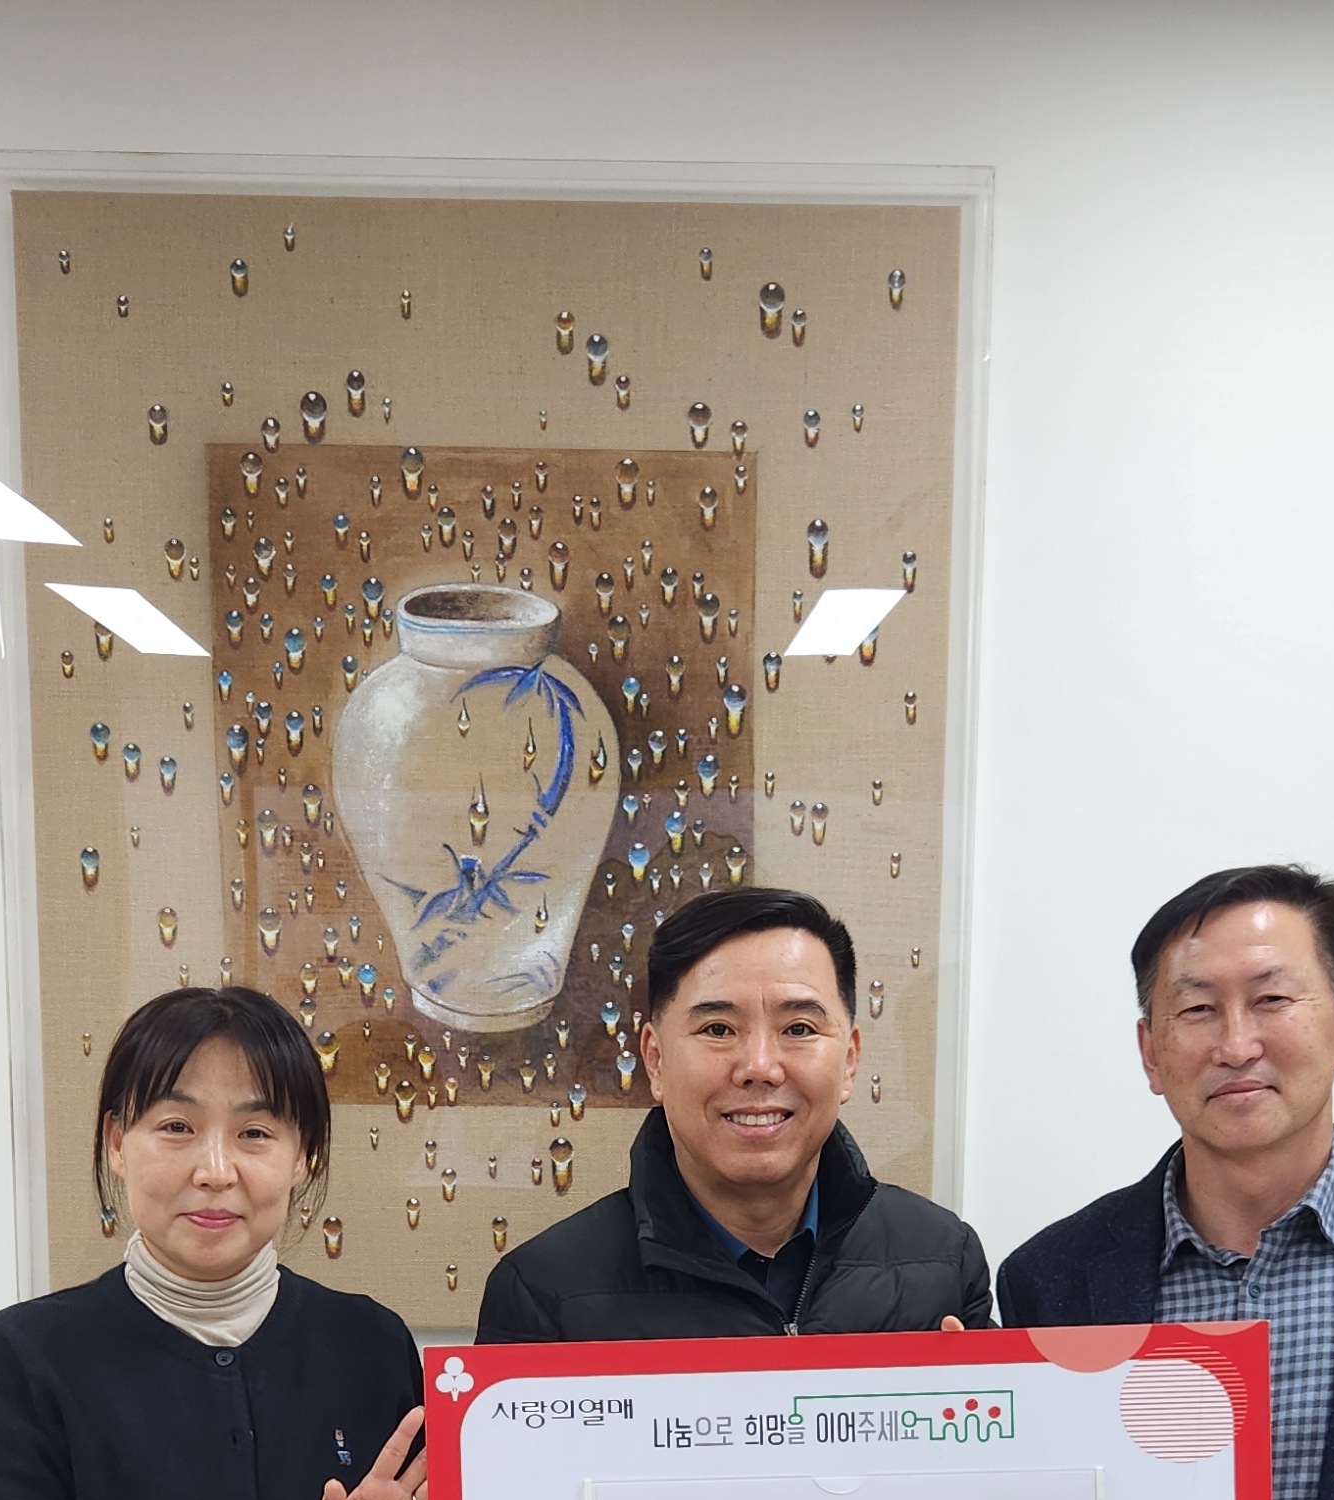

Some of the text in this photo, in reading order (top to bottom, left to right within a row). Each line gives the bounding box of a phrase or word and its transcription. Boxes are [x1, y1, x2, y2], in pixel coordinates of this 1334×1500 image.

[491, 1397, 634, 1430] 사랑의열매
[653, 1409, 920, 1449] 나눔으로 희망을 이어주세요
